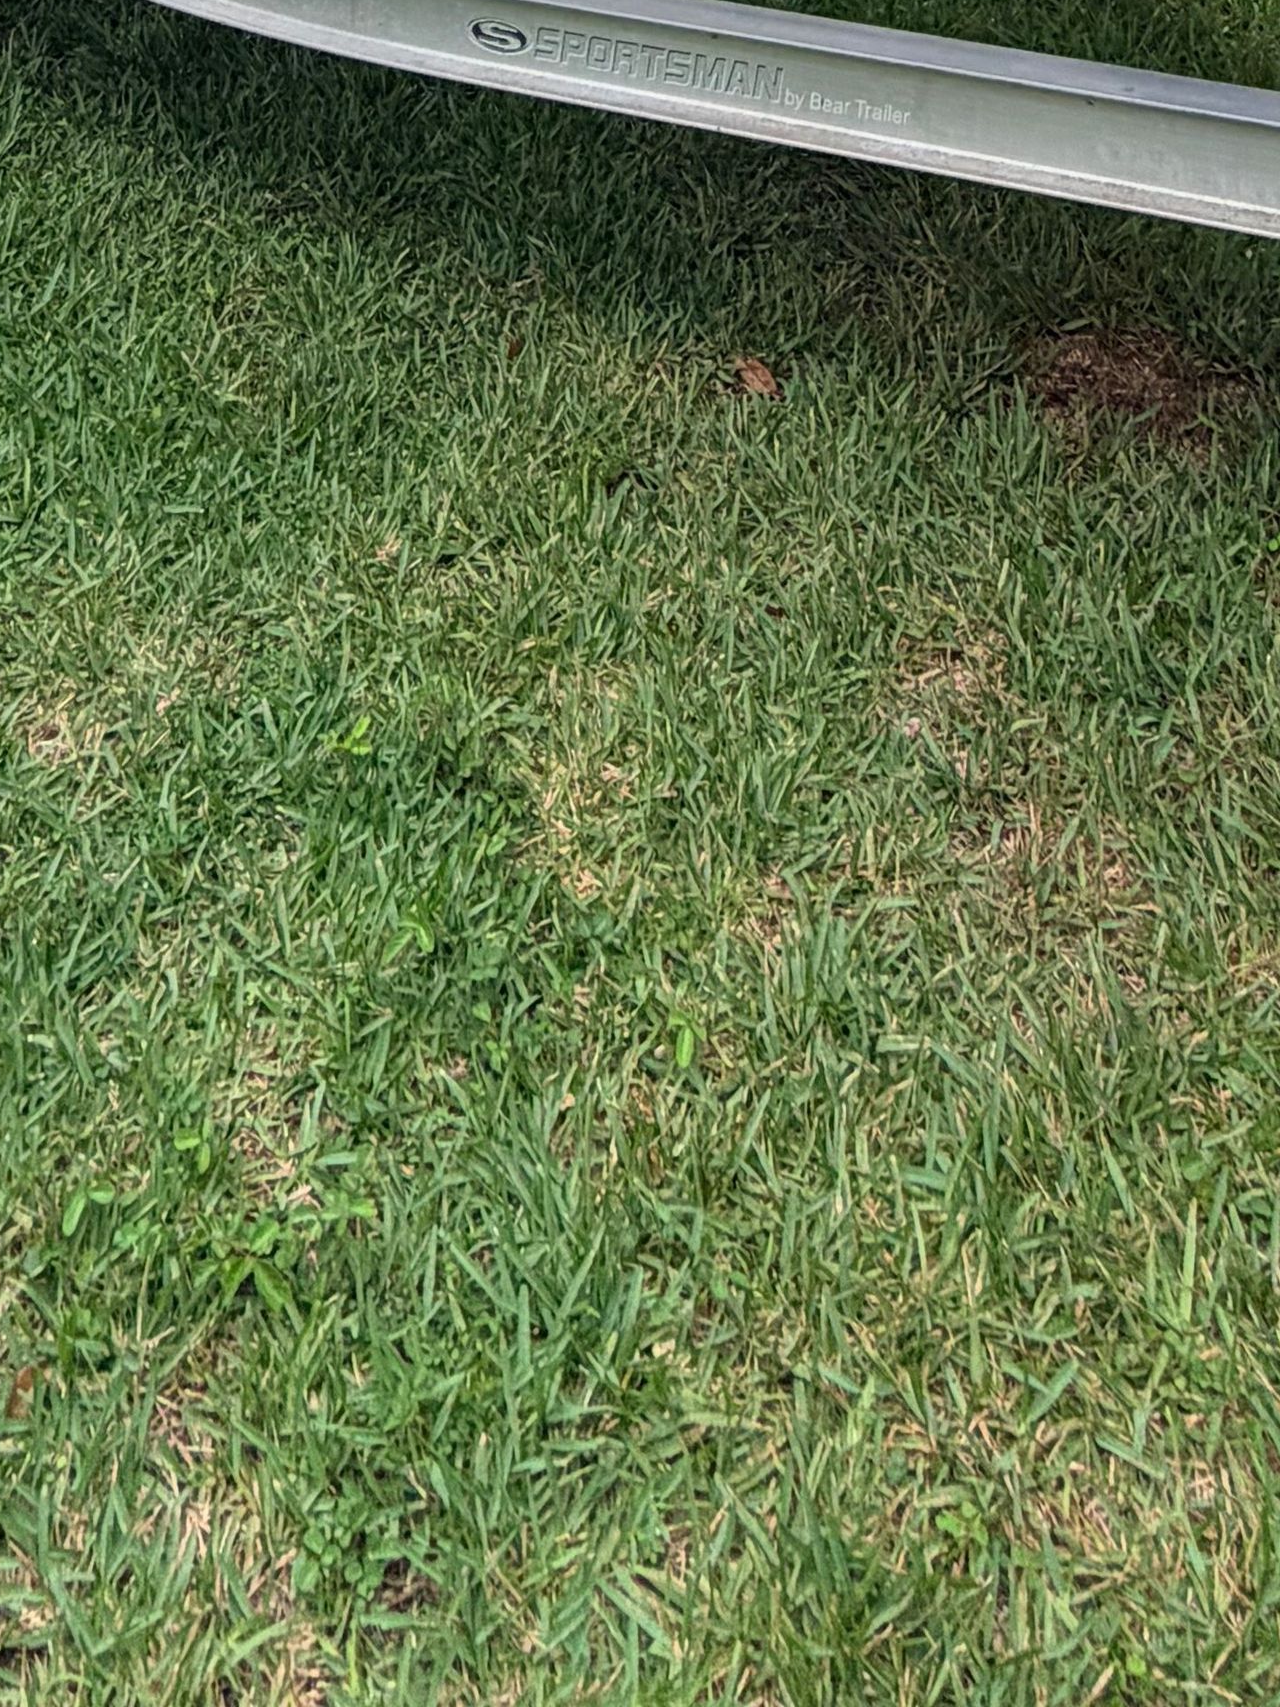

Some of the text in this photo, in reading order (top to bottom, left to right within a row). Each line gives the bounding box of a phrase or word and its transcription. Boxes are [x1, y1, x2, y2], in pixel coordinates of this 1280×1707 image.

[534, 26, 784, 104] SPORTSMAN
[784, 89, 805, 111] by
[809, 92, 851, 115] Bear
[856, 99, 911, 125] Trailer
